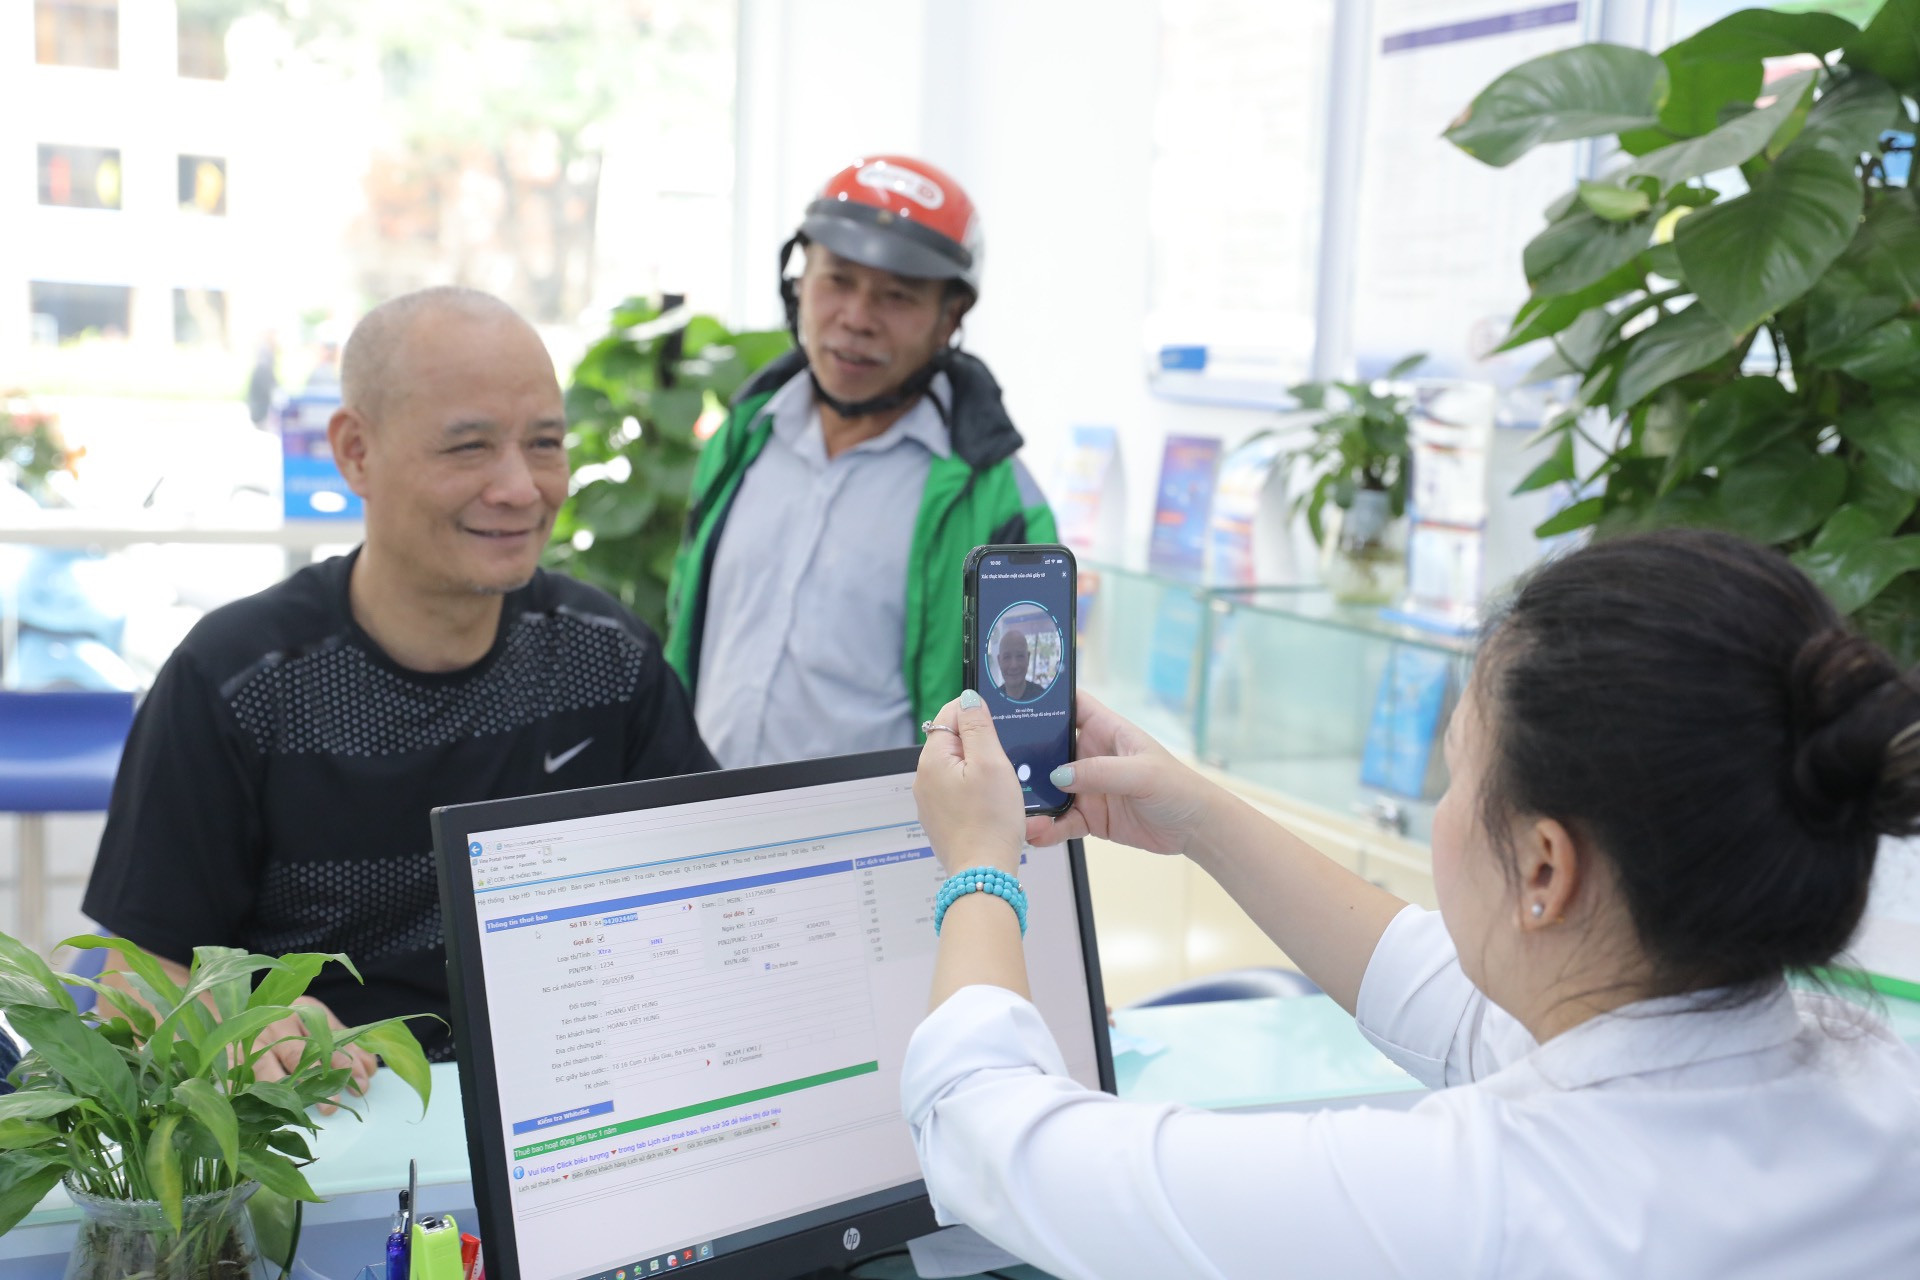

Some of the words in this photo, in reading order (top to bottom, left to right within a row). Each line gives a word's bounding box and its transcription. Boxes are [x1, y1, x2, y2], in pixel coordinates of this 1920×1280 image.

[536, 914, 548, 922] bao
[532, 1145, 544, 1153] bao
[556, 1160, 572, 1170] Click
[637, 1141, 646, 1149] tab
[846, 1229, 858, 1250] hp
